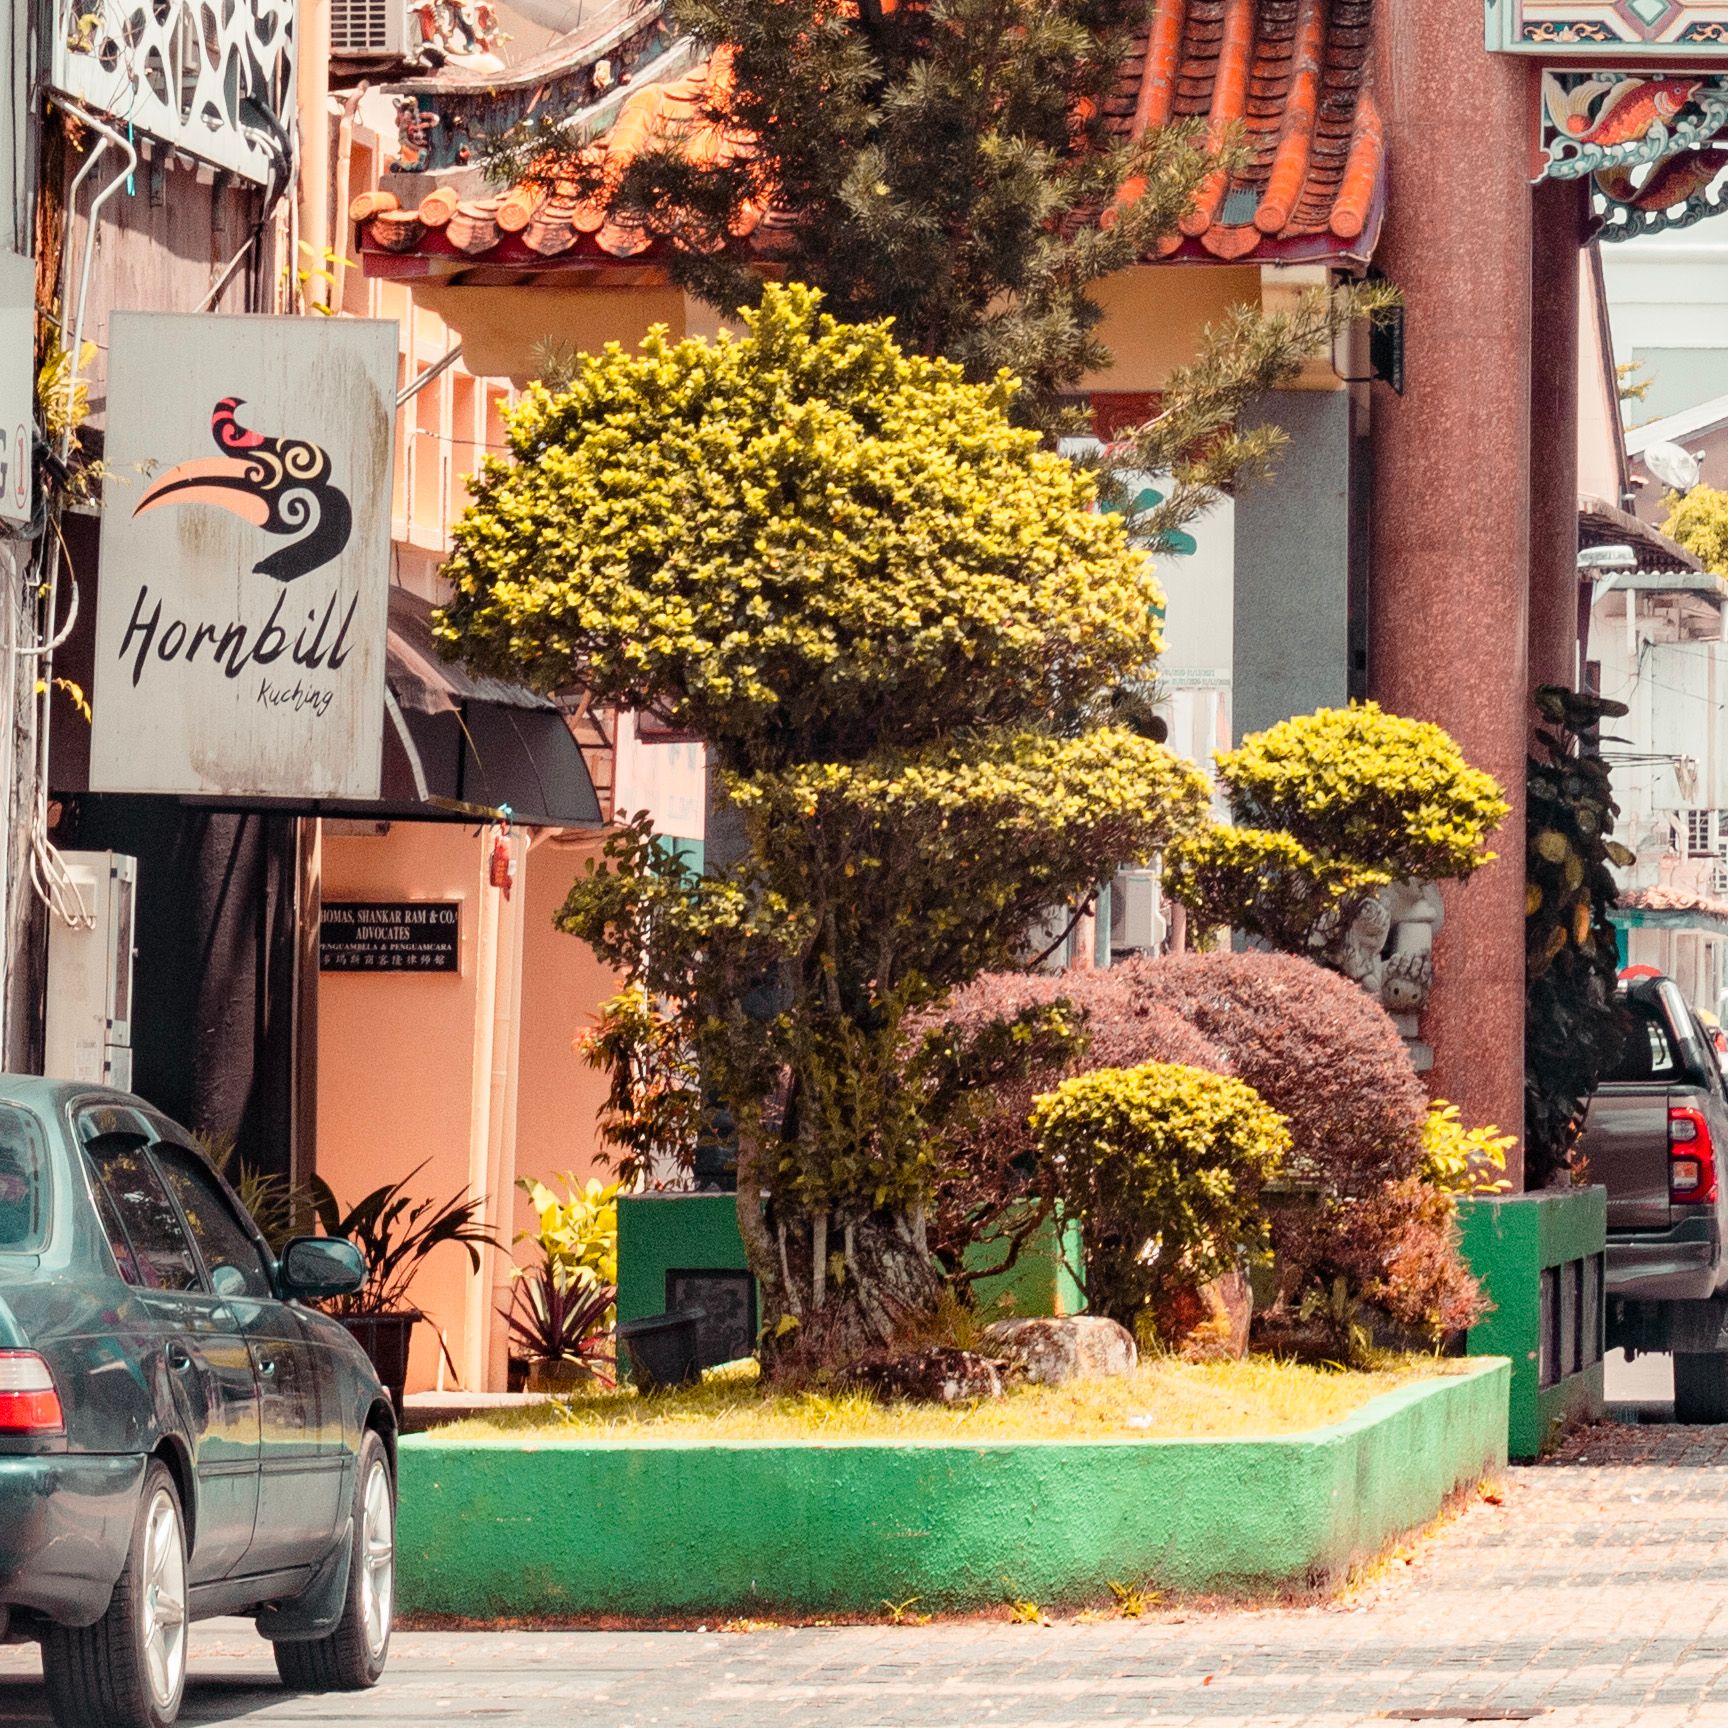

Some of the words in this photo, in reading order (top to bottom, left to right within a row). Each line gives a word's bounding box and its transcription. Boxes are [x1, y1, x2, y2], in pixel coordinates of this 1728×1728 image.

[119, 585, 359, 687] Hornbill
[257, 678, 334, 717] Kuching
[321, 909, 355, 924] HOMAS,
[357, 910, 401, 924] SHANKAR
[405, 909, 426, 924] RAM
[429, 909, 439, 924] &
[440, 909, 455, 924] CO.
[356, 926, 410, 941] ADVOCATES
